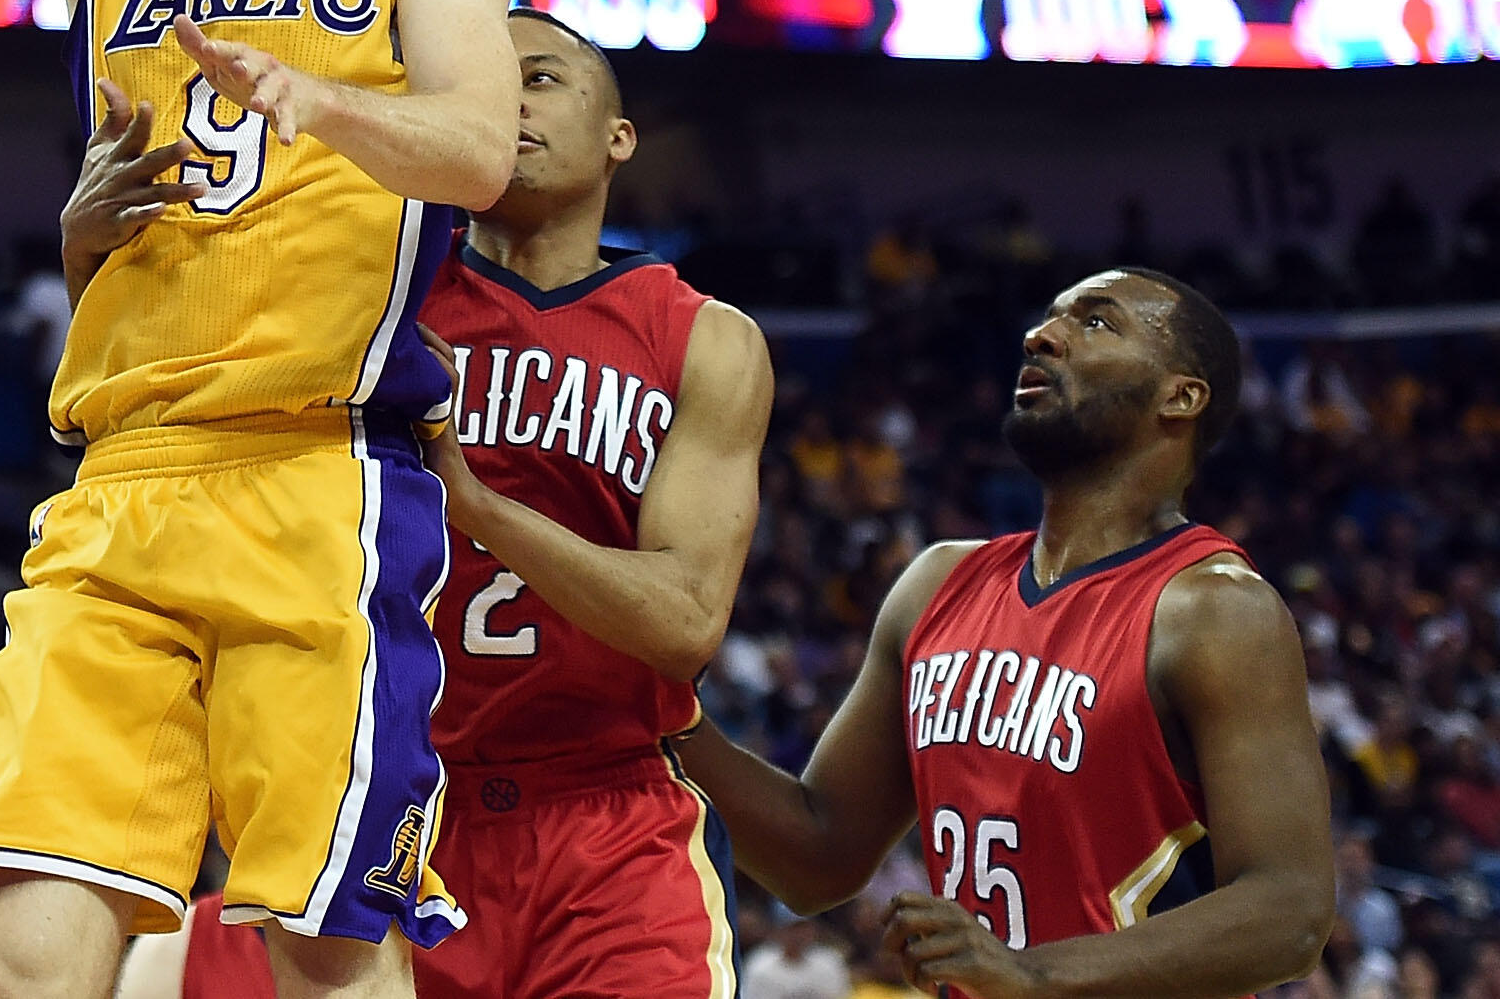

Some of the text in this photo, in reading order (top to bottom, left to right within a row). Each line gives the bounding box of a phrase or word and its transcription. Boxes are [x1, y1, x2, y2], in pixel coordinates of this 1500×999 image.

[180, 71, 270, 216] 9
[453, 346, 675, 495] LICANS
[908, 648, 1098, 774] PELICANS
